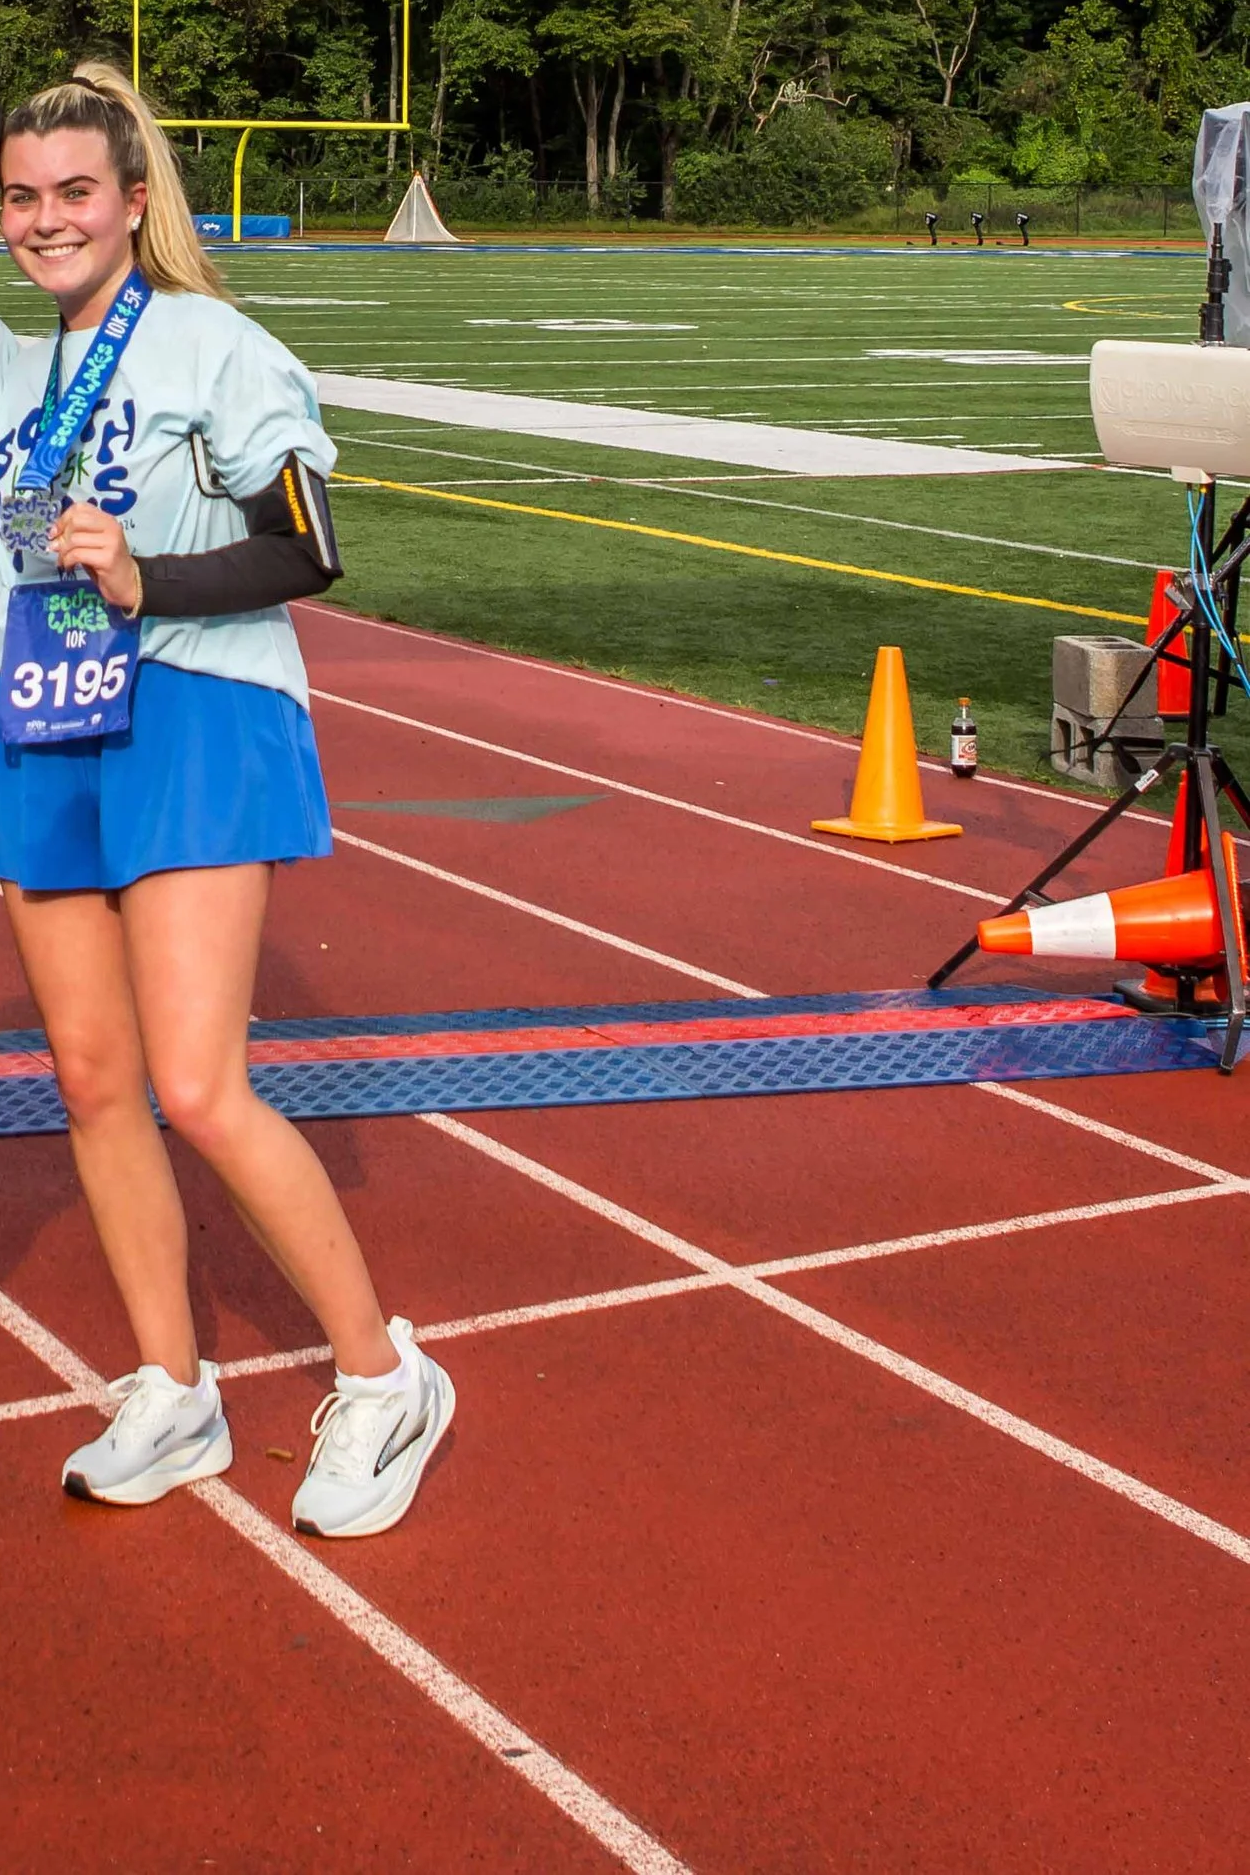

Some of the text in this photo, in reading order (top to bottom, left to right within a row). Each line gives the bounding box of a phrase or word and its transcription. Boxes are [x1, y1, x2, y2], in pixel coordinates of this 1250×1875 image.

[51, 391, 89, 448] SOUTH
[75, 342, 114, 397] LAKES
[104, 312, 130, 339] 10K
[123, 286, 144, 309] 5K
[47, 607, 110, 634] LAKES
[65, 629, 87, 648] 10K
[10, 654, 128, 709] 3195
